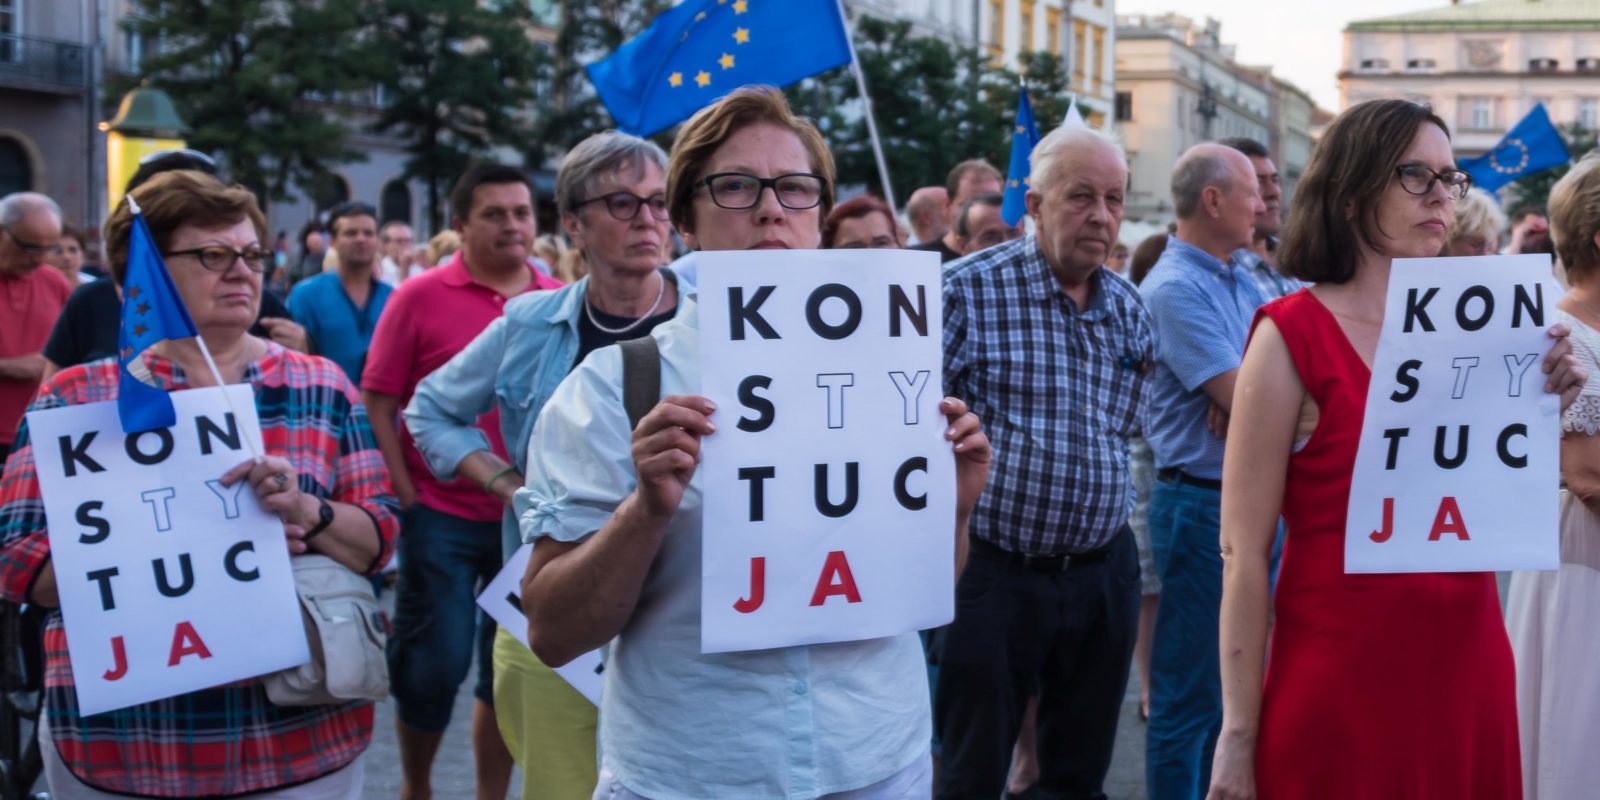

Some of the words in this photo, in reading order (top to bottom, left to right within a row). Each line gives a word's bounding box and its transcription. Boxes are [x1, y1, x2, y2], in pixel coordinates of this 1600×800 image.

[727, 283, 929, 341] KON
[1402, 283, 1545, 333] KON
[735, 370, 931, 433] STY
[1389, 353, 1539, 403] STY
[58, 412, 242, 478] KON
[1383, 423, 1529, 470] TUC
[75, 478, 247, 545] STY
[738, 456, 929, 522] TUC
[1368, 496, 1471, 544] JA
[86, 540, 261, 612] TUC
[732, 551, 863, 614] JA
[102, 621, 213, 682] JA
